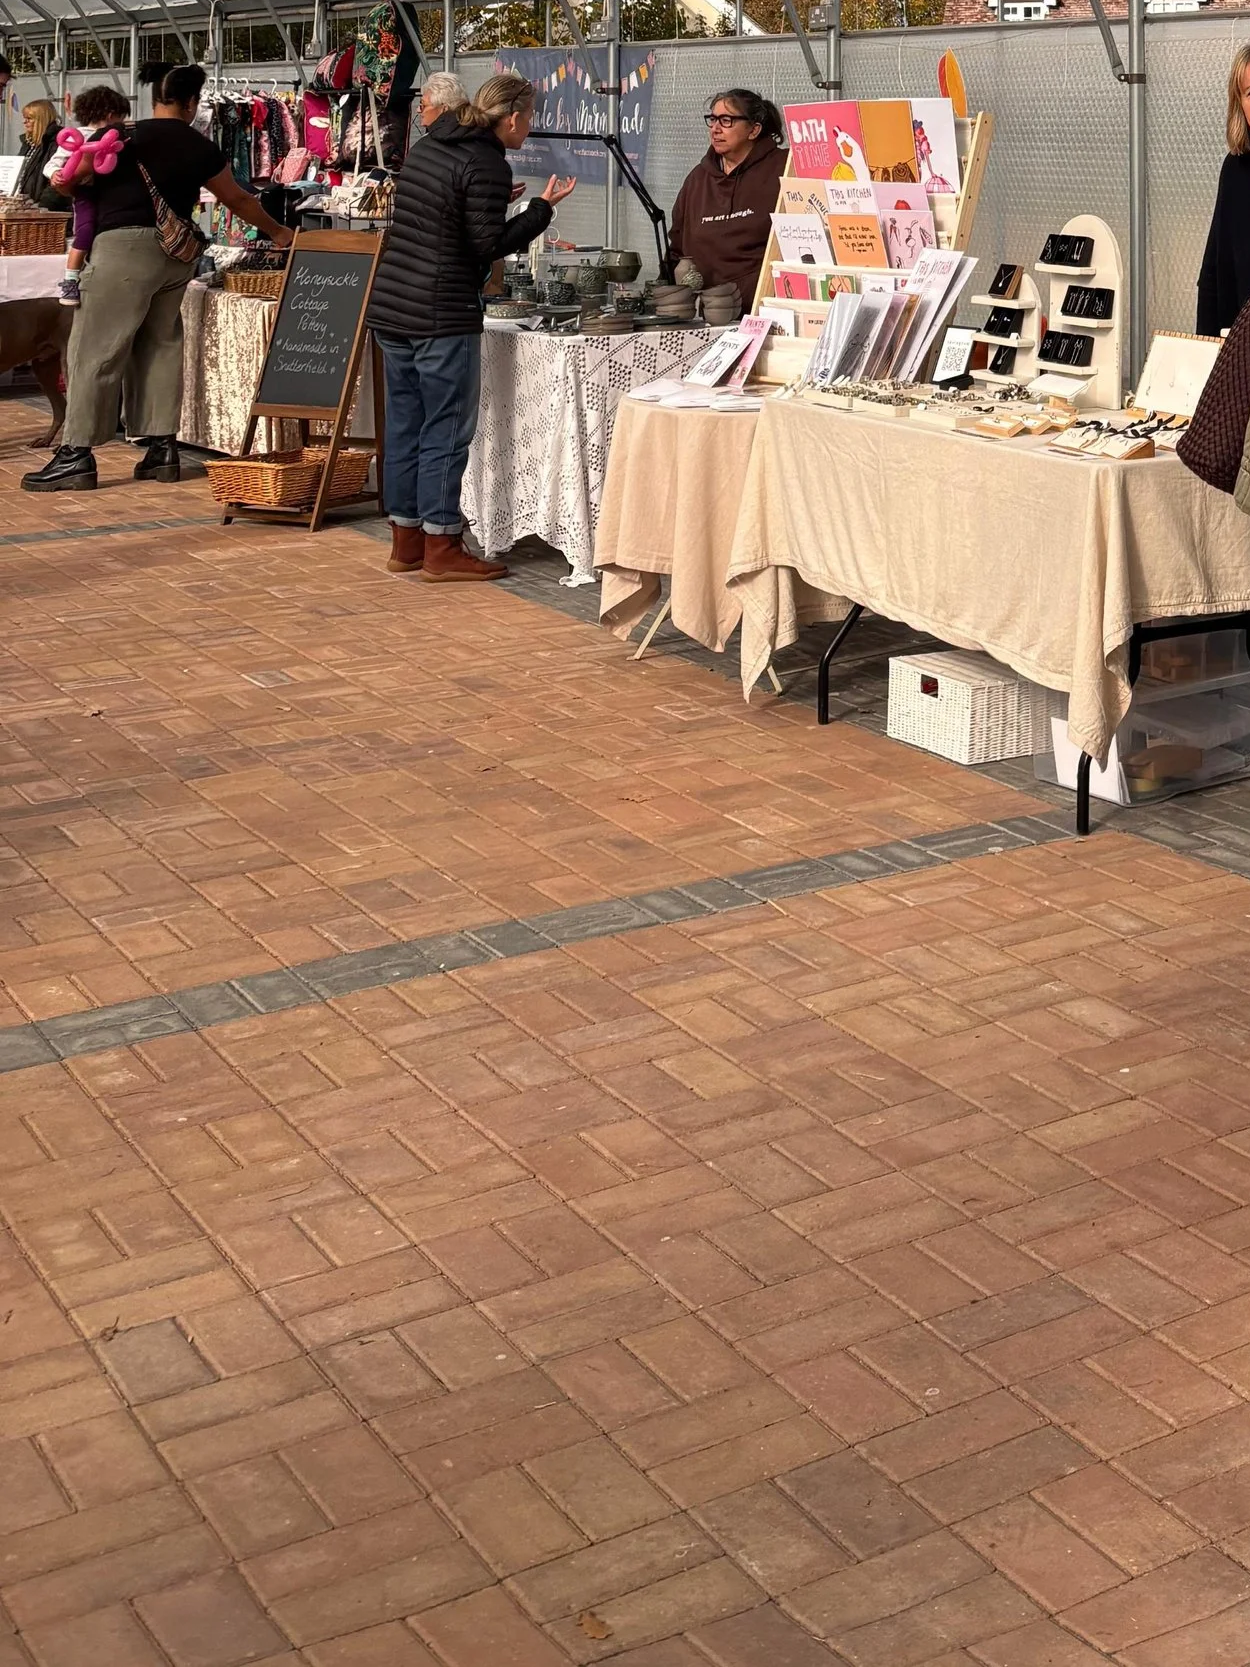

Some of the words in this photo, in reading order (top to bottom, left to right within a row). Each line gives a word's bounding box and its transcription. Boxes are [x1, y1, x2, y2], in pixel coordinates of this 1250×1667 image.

[575, 99, 645, 135] Marmlade
[790, 118, 829, 143] BATH
[293, 266, 360, 297] Honeysuckle
[290, 293, 329, 319] Cottage
[296, 313, 328, 340] Pottery
[282, 338, 327, 354] handmade
[329, 345, 340, 354] in
[719, 340, 740, 350] PRINTS
